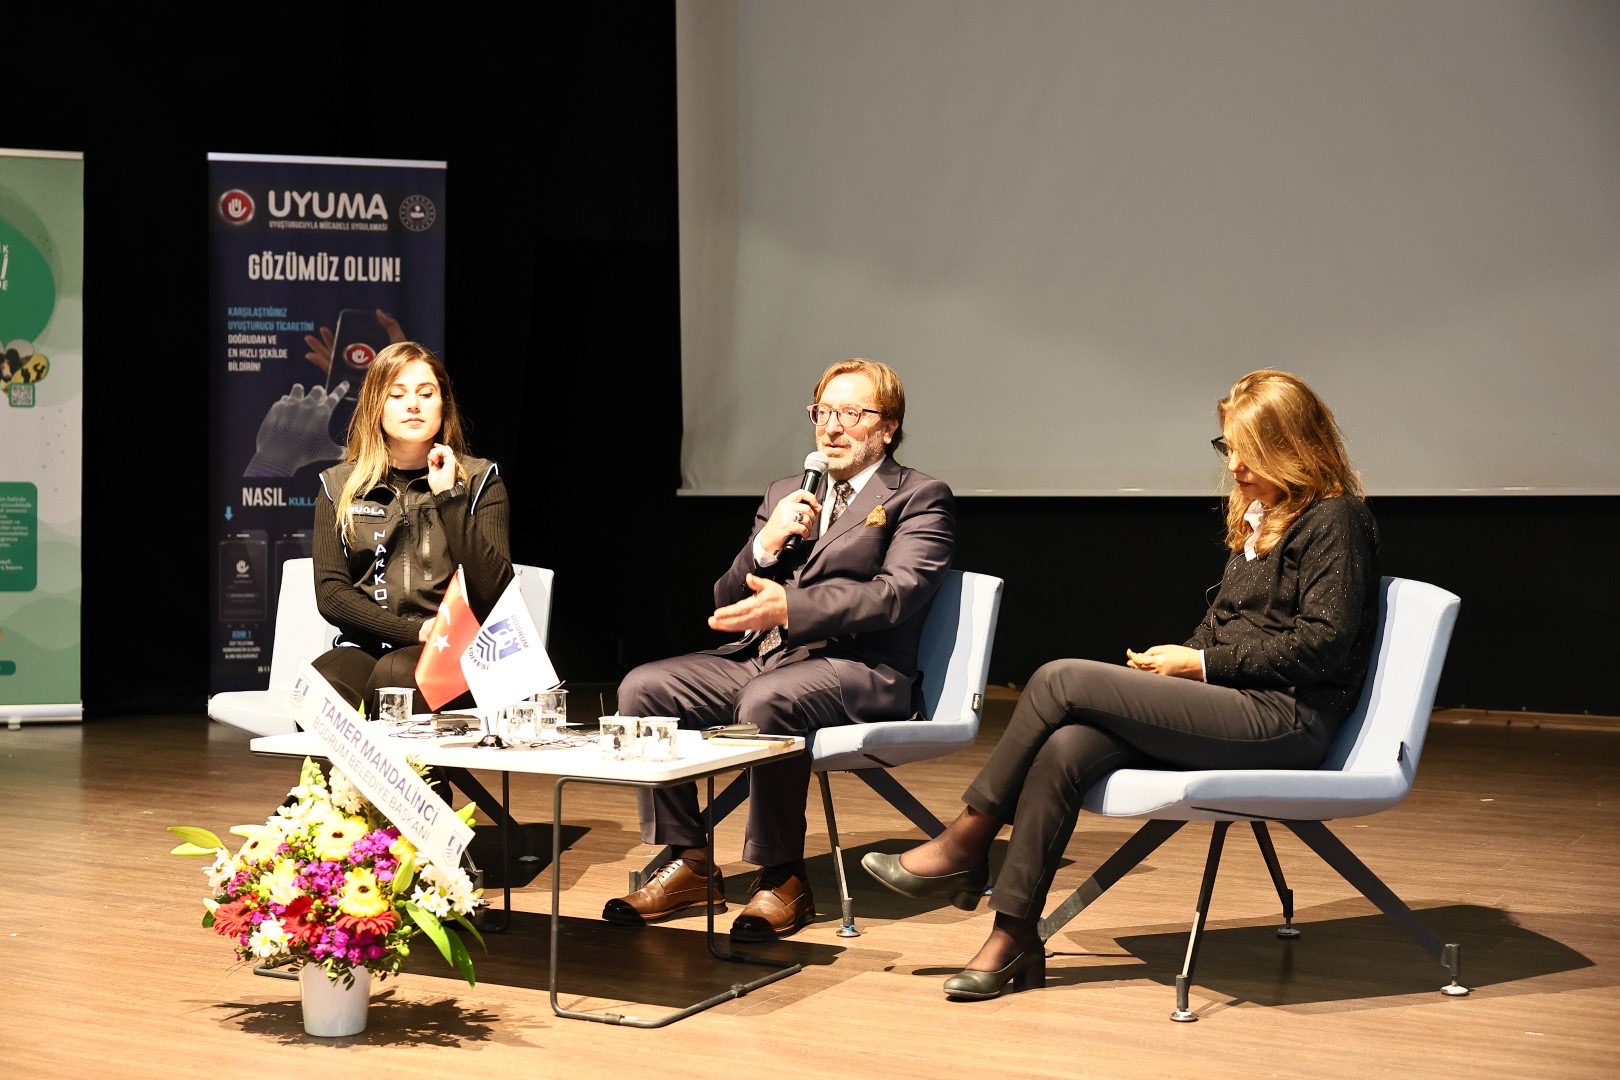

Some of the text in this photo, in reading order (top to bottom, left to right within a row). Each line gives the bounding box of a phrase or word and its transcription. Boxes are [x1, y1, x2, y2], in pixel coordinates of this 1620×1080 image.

[268, 190, 389, 220] UYUMA
[248, 250, 401, 282] GÖZÜMÜZ OLUN!
[227, 320, 275, 332] UYUŞTURUCU
[227, 333, 278, 345] DOĞRUDAN VE
[227, 347, 289, 360] EN HIZLI ŞEKİLDE
[242, 487, 287, 507] NASIL
[312, 716, 351, 758] BODRUM
[347, 754, 391, 803] BELEDİYE
[320, 697, 440, 826] TAMER MANDALİNCİ
